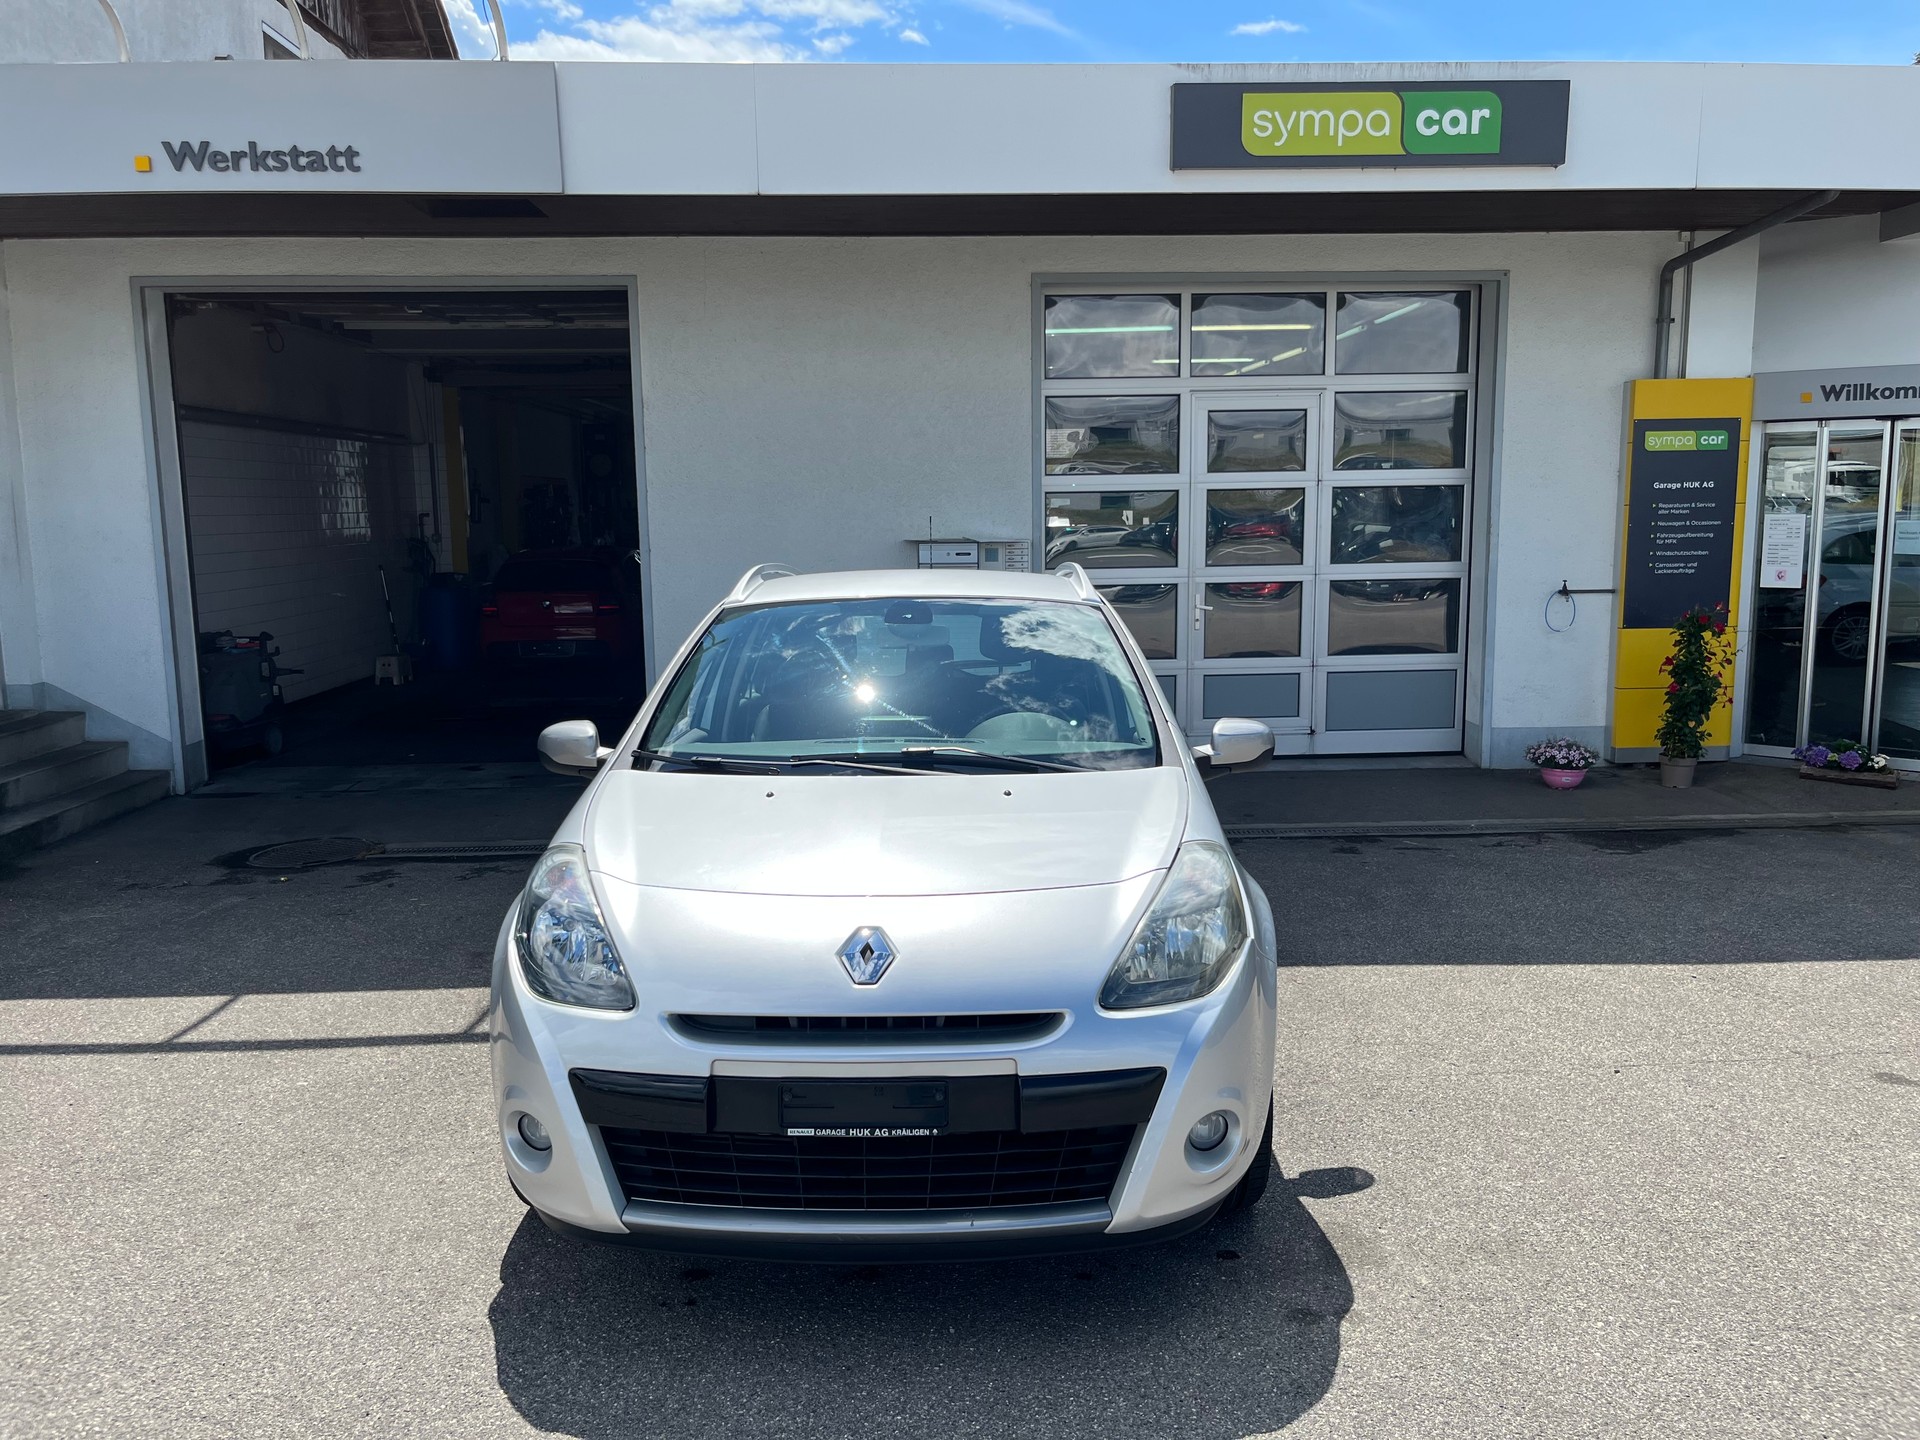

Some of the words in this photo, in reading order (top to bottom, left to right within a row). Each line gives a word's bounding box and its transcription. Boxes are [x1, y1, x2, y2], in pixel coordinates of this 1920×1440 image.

[1252, 109, 1391, 147] sympa
[1415, 107, 1491, 137] car
[160, 140, 362, 173] Werkstatt
[1820, 383, 1920, 402] Willkom
[1648, 436, 1693, 448] sympa
[1700, 435, 1725, 445] car
[1653, 481, 1681, 490] Garage
[1683, 481, 1700, 489] HUK
[849, 1128, 871, 1136] HUK
[874, 1128, 889, 1136] AG
